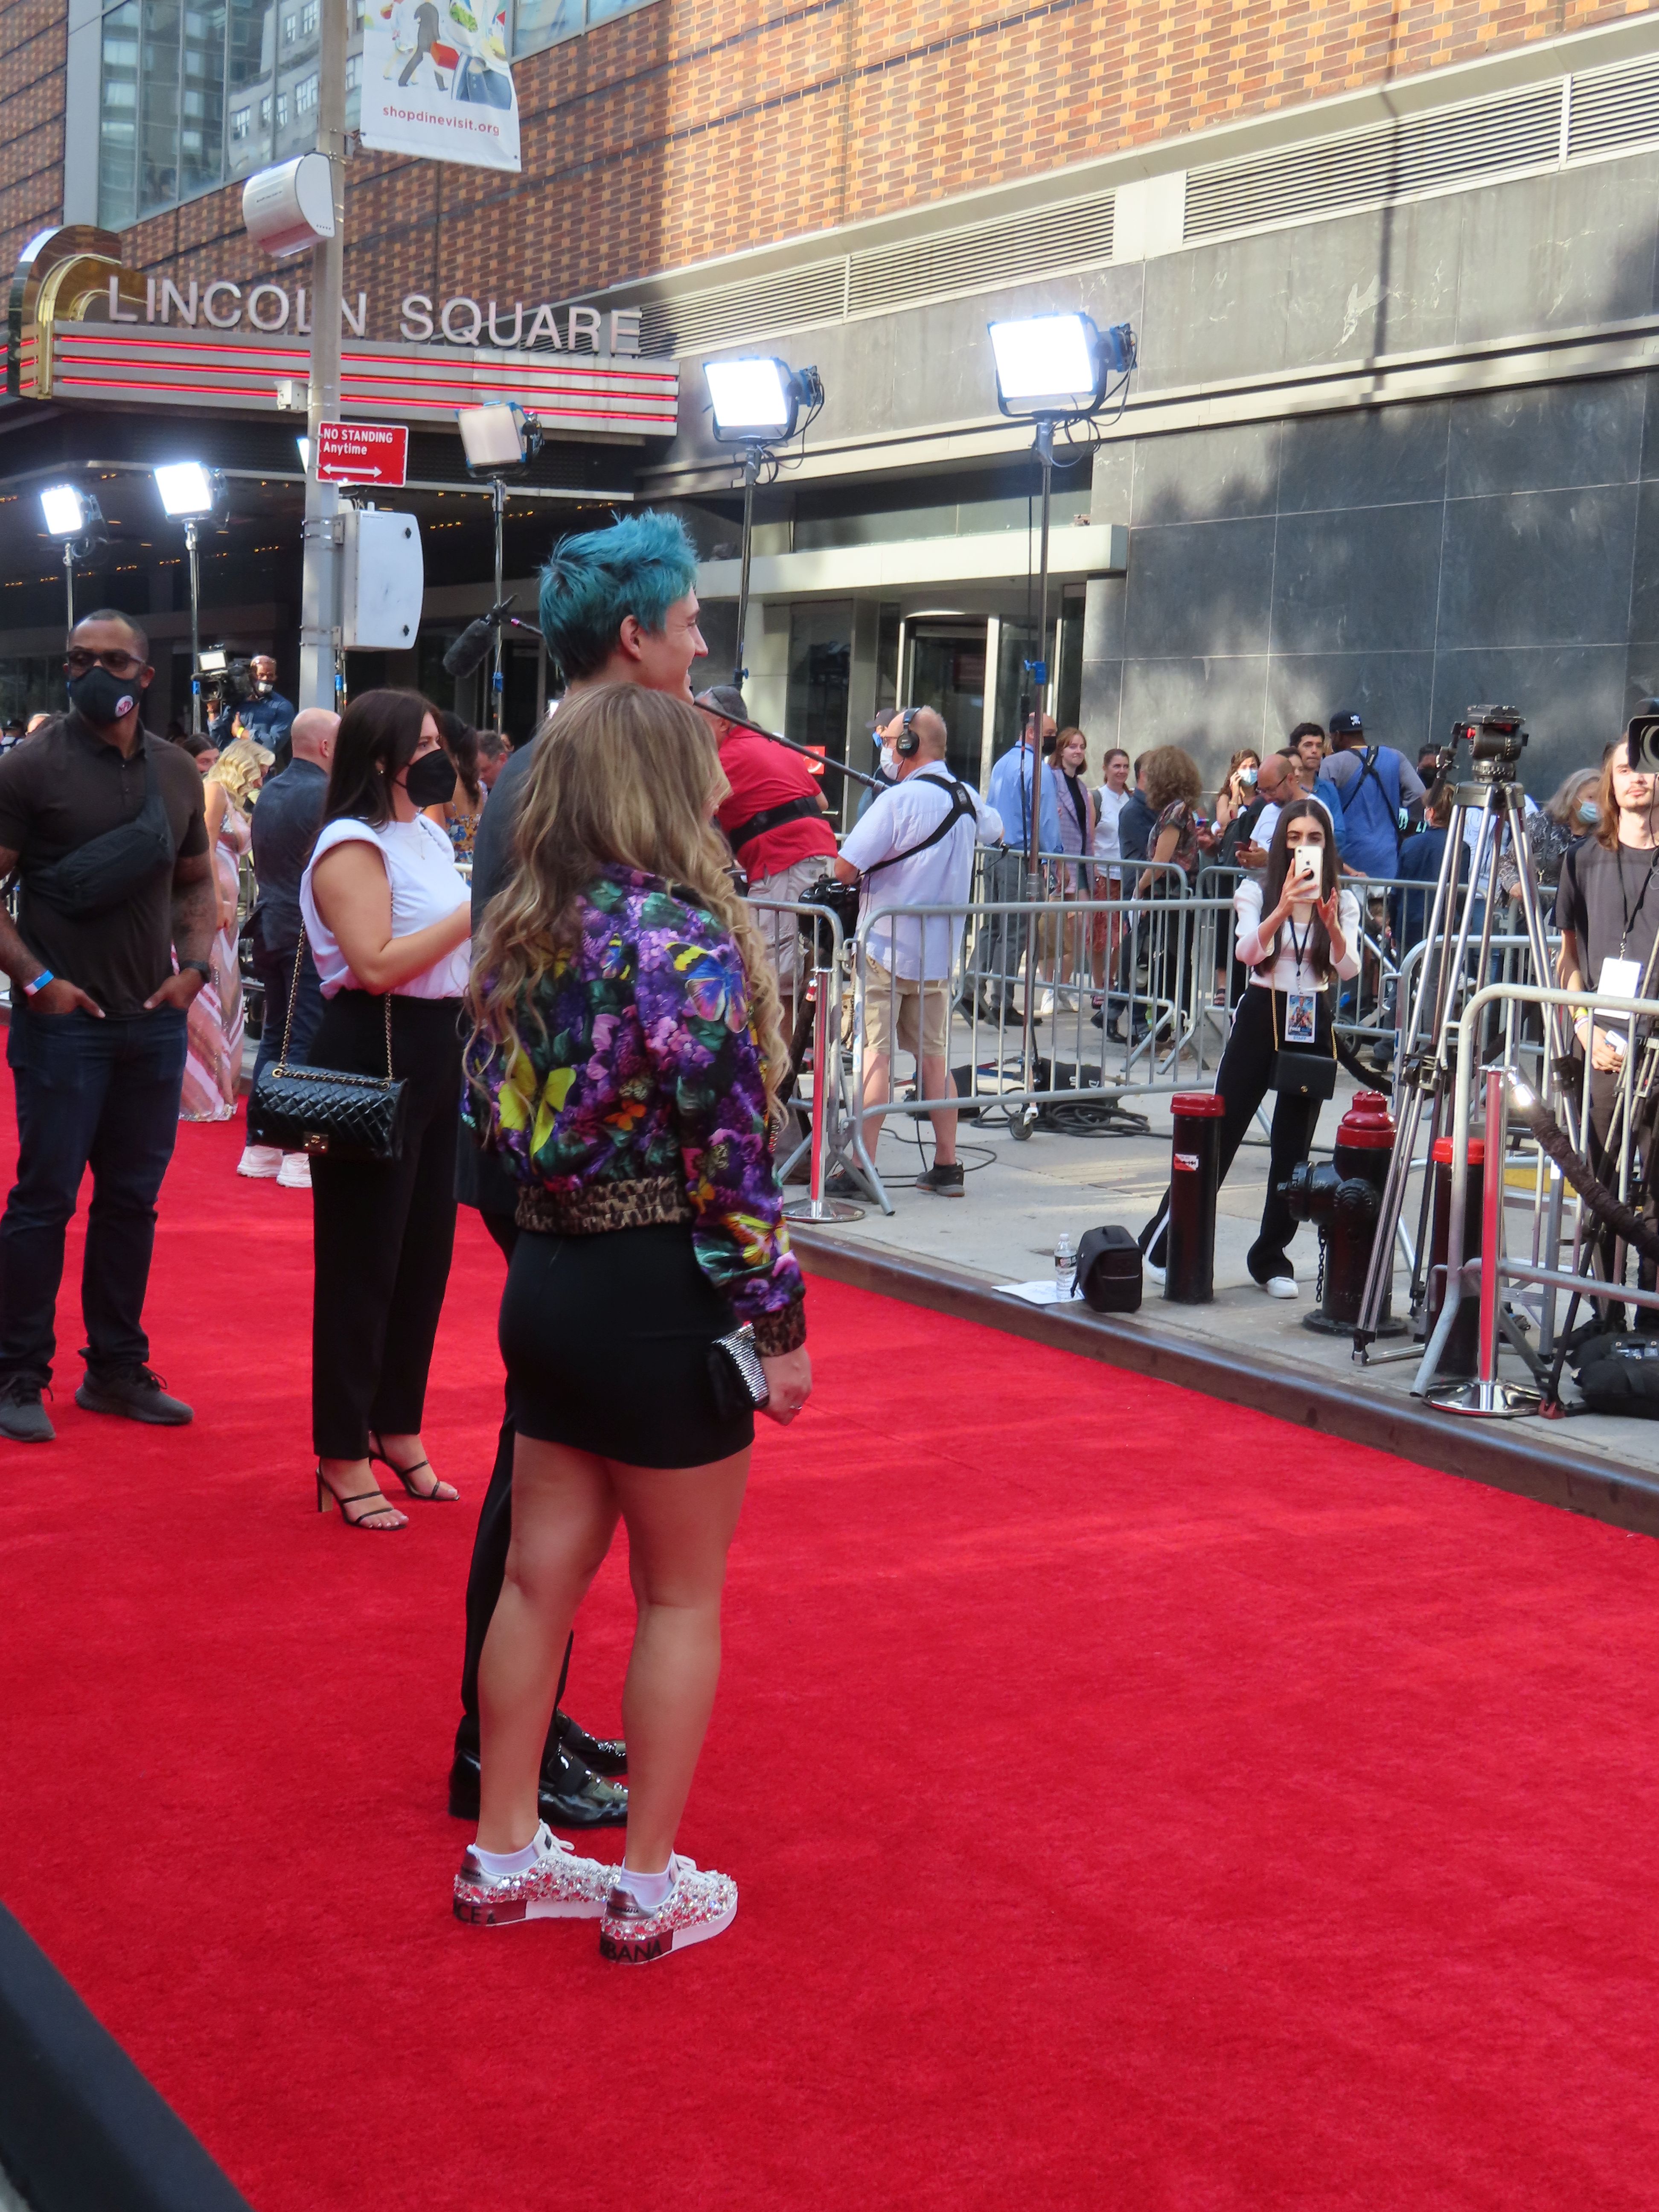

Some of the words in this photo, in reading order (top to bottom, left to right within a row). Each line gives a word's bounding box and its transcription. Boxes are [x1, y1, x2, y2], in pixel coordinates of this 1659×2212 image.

[382, 105, 500, 136] shopdinevisit.org
[108, 276, 367, 336] LINCOLN
[399, 294, 643, 355] SQUARE
[323, 428, 338, 440] NO
[341, 430, 393, 443] STANDING
[323, 442, 367, 456] Anytime
